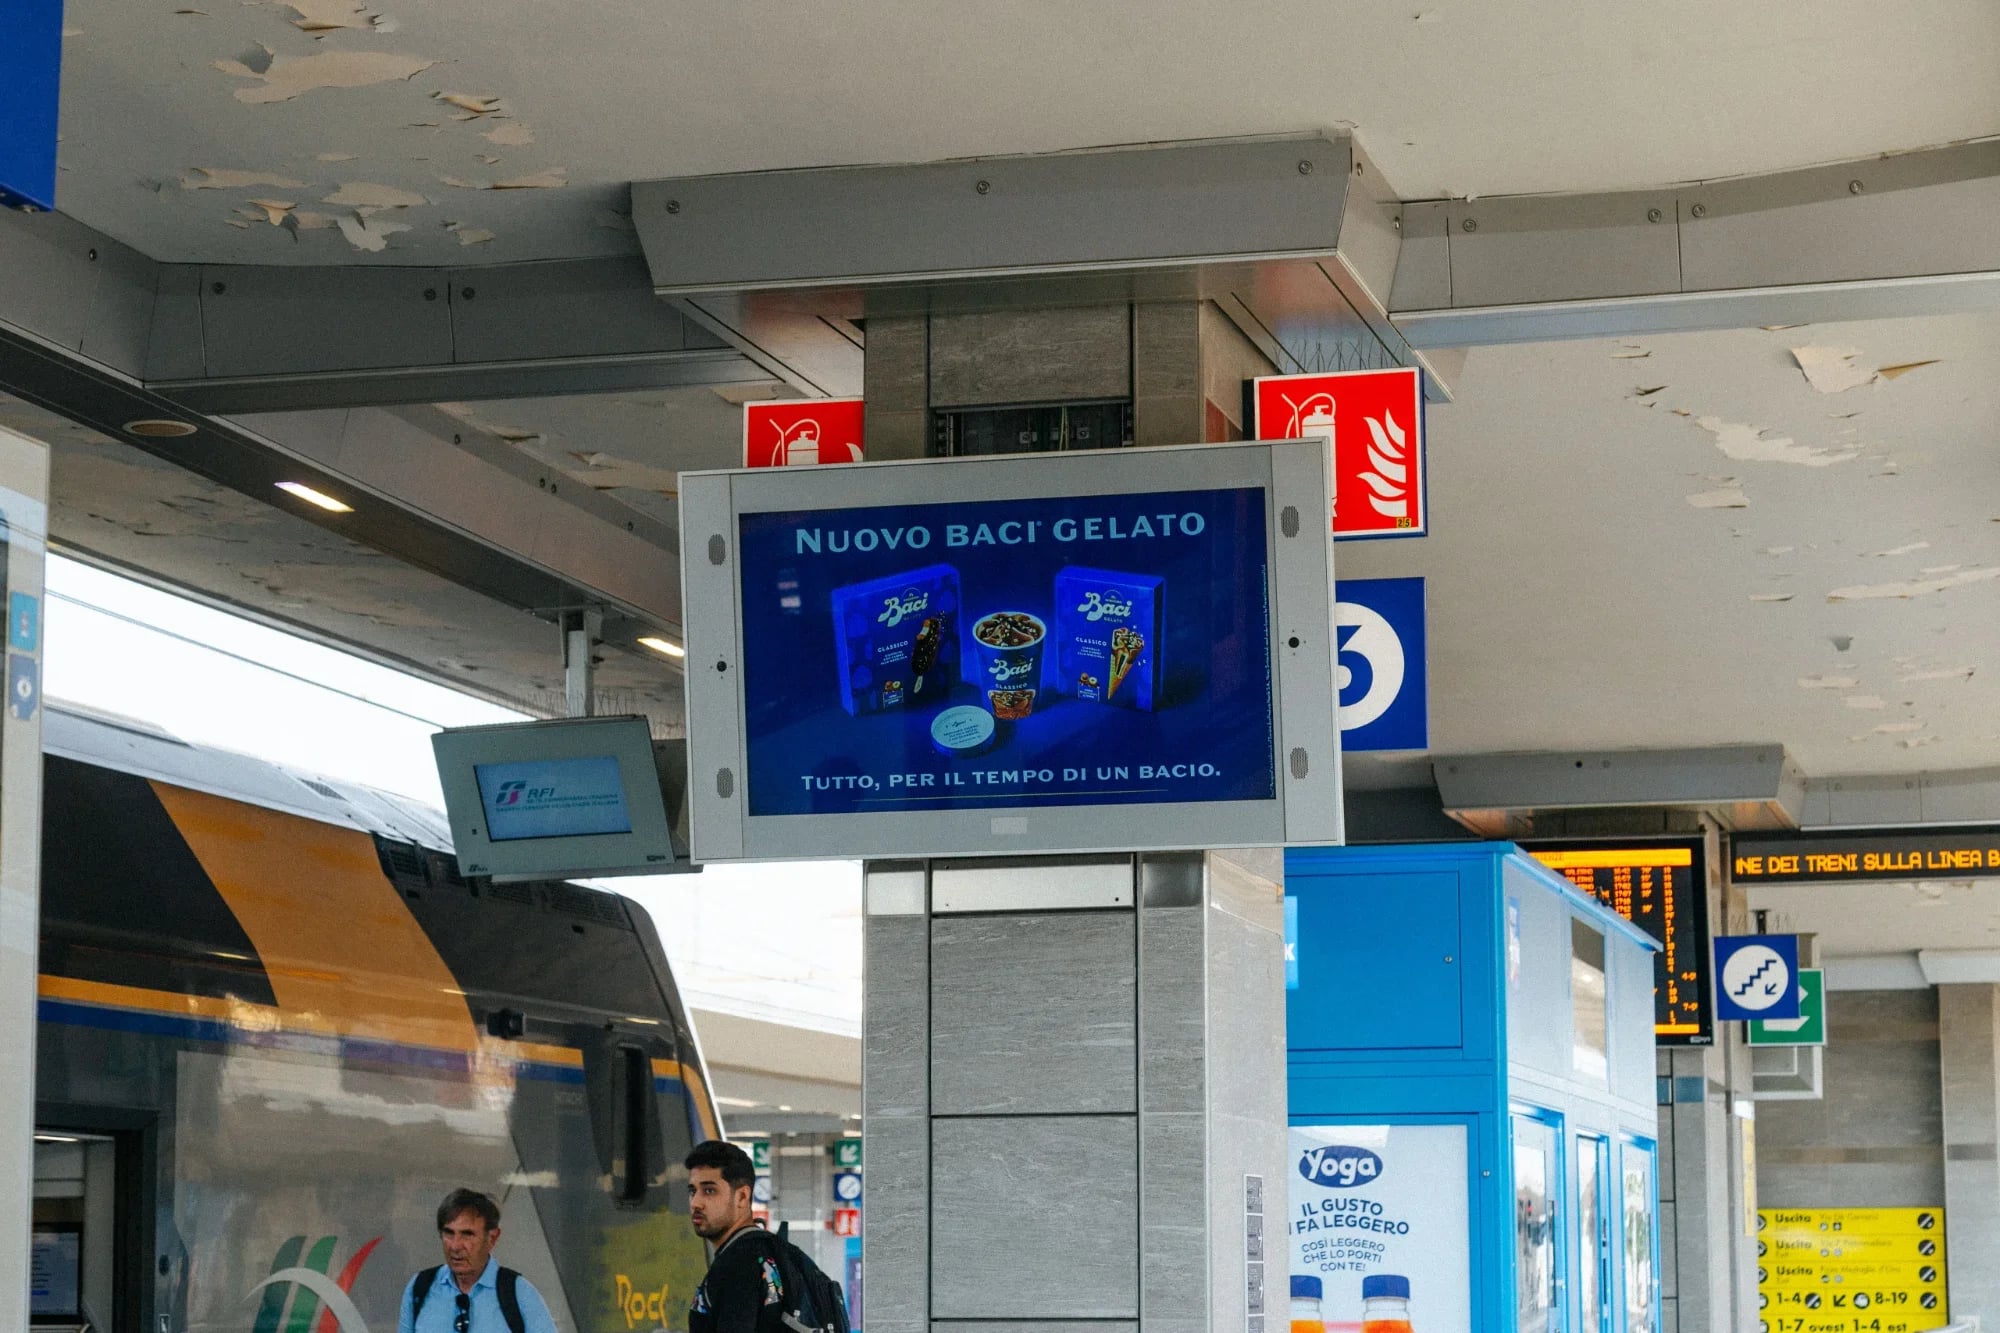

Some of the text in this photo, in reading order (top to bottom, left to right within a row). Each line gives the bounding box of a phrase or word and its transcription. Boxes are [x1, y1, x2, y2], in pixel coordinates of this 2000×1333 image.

[796, 527, 931, 554] NUOVO
[1053, 512, 1205, 542] GELATO
[878, 592, 928, 627] Baci
[1077, 591, 1132, 621] Baci
[877, 640, 909, 653] CLASSICO
[1075, 636, 1107, 647] CLASSICO
[988, 657, 1034, 681] Baci
[801, 763, 1221, 791] TUTTO, PER IL TEMPO DI UN BACIO.
[527, 787, 555, 799] RFI
[1768, 856, 1799, 874] DEI
[1806, 854, 1858, 872] TRENI
[1864, 852, 1922, 870] SULLA
[1928, 850, 1982, 868] LINEA
[1304, 1149, 1377, 1185] Yoga
[1302, 1198, 1383, 1217] IL GUSTO
[1296, 1218, 1320, 1234] FA
[1323, 1215, 1410, 1235] LEGGERO
[1775, 1213, 1812, 1223] Uscita
[1331, 1238, 1385, 1252] LEGGERO
[1776, 1239, 1812, 1249] Uscita
[1303, 1249, 1382, 1264] CHE LO PORTI
[1320, 1262, 1366, 1272] CON TE!
[1776, 1265, 1813, 1275] Uscita
[1777, 1292, 1908, 1304] 1-4 8-19
[1778, 1319, 1907, 1332] 1-7 ovest 1-4 est
